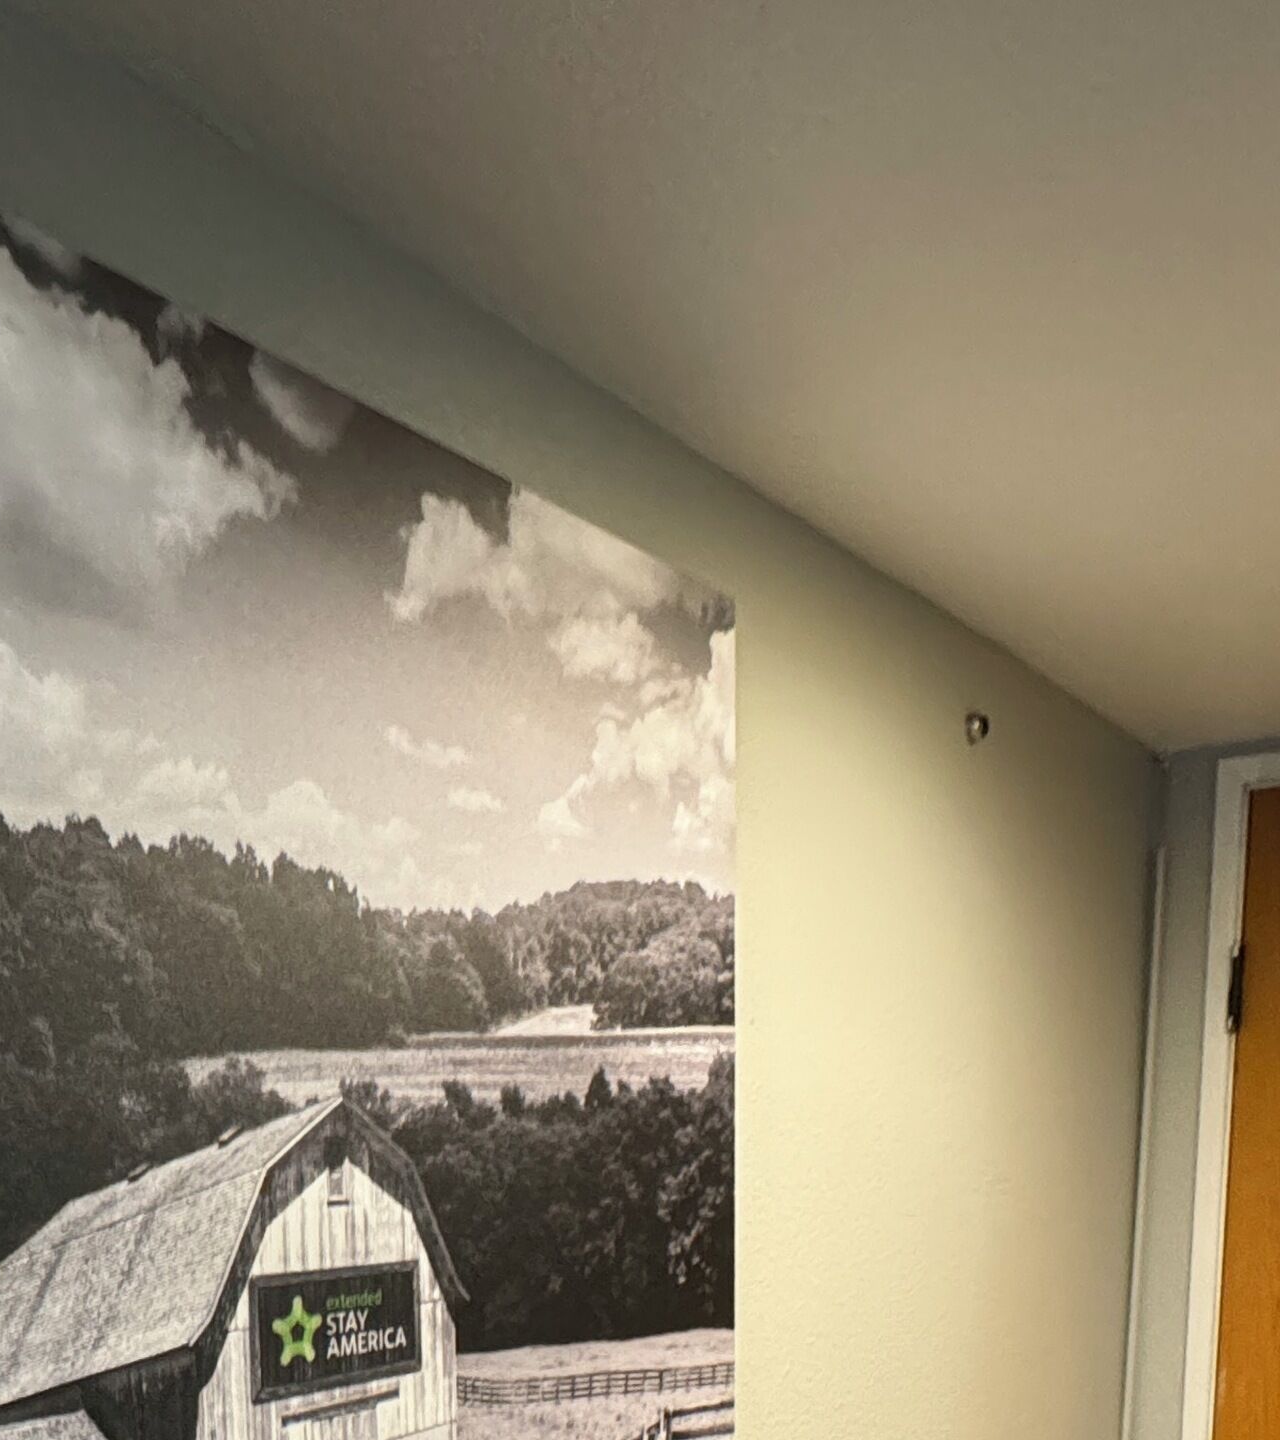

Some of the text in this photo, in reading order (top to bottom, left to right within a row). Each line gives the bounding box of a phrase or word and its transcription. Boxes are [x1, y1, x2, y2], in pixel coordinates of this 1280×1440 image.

[326, 1289, 382, 1310] extended
[326, 1310, 369, 1336] STAY
[326, 1326, 407, 1360] AMERICA
